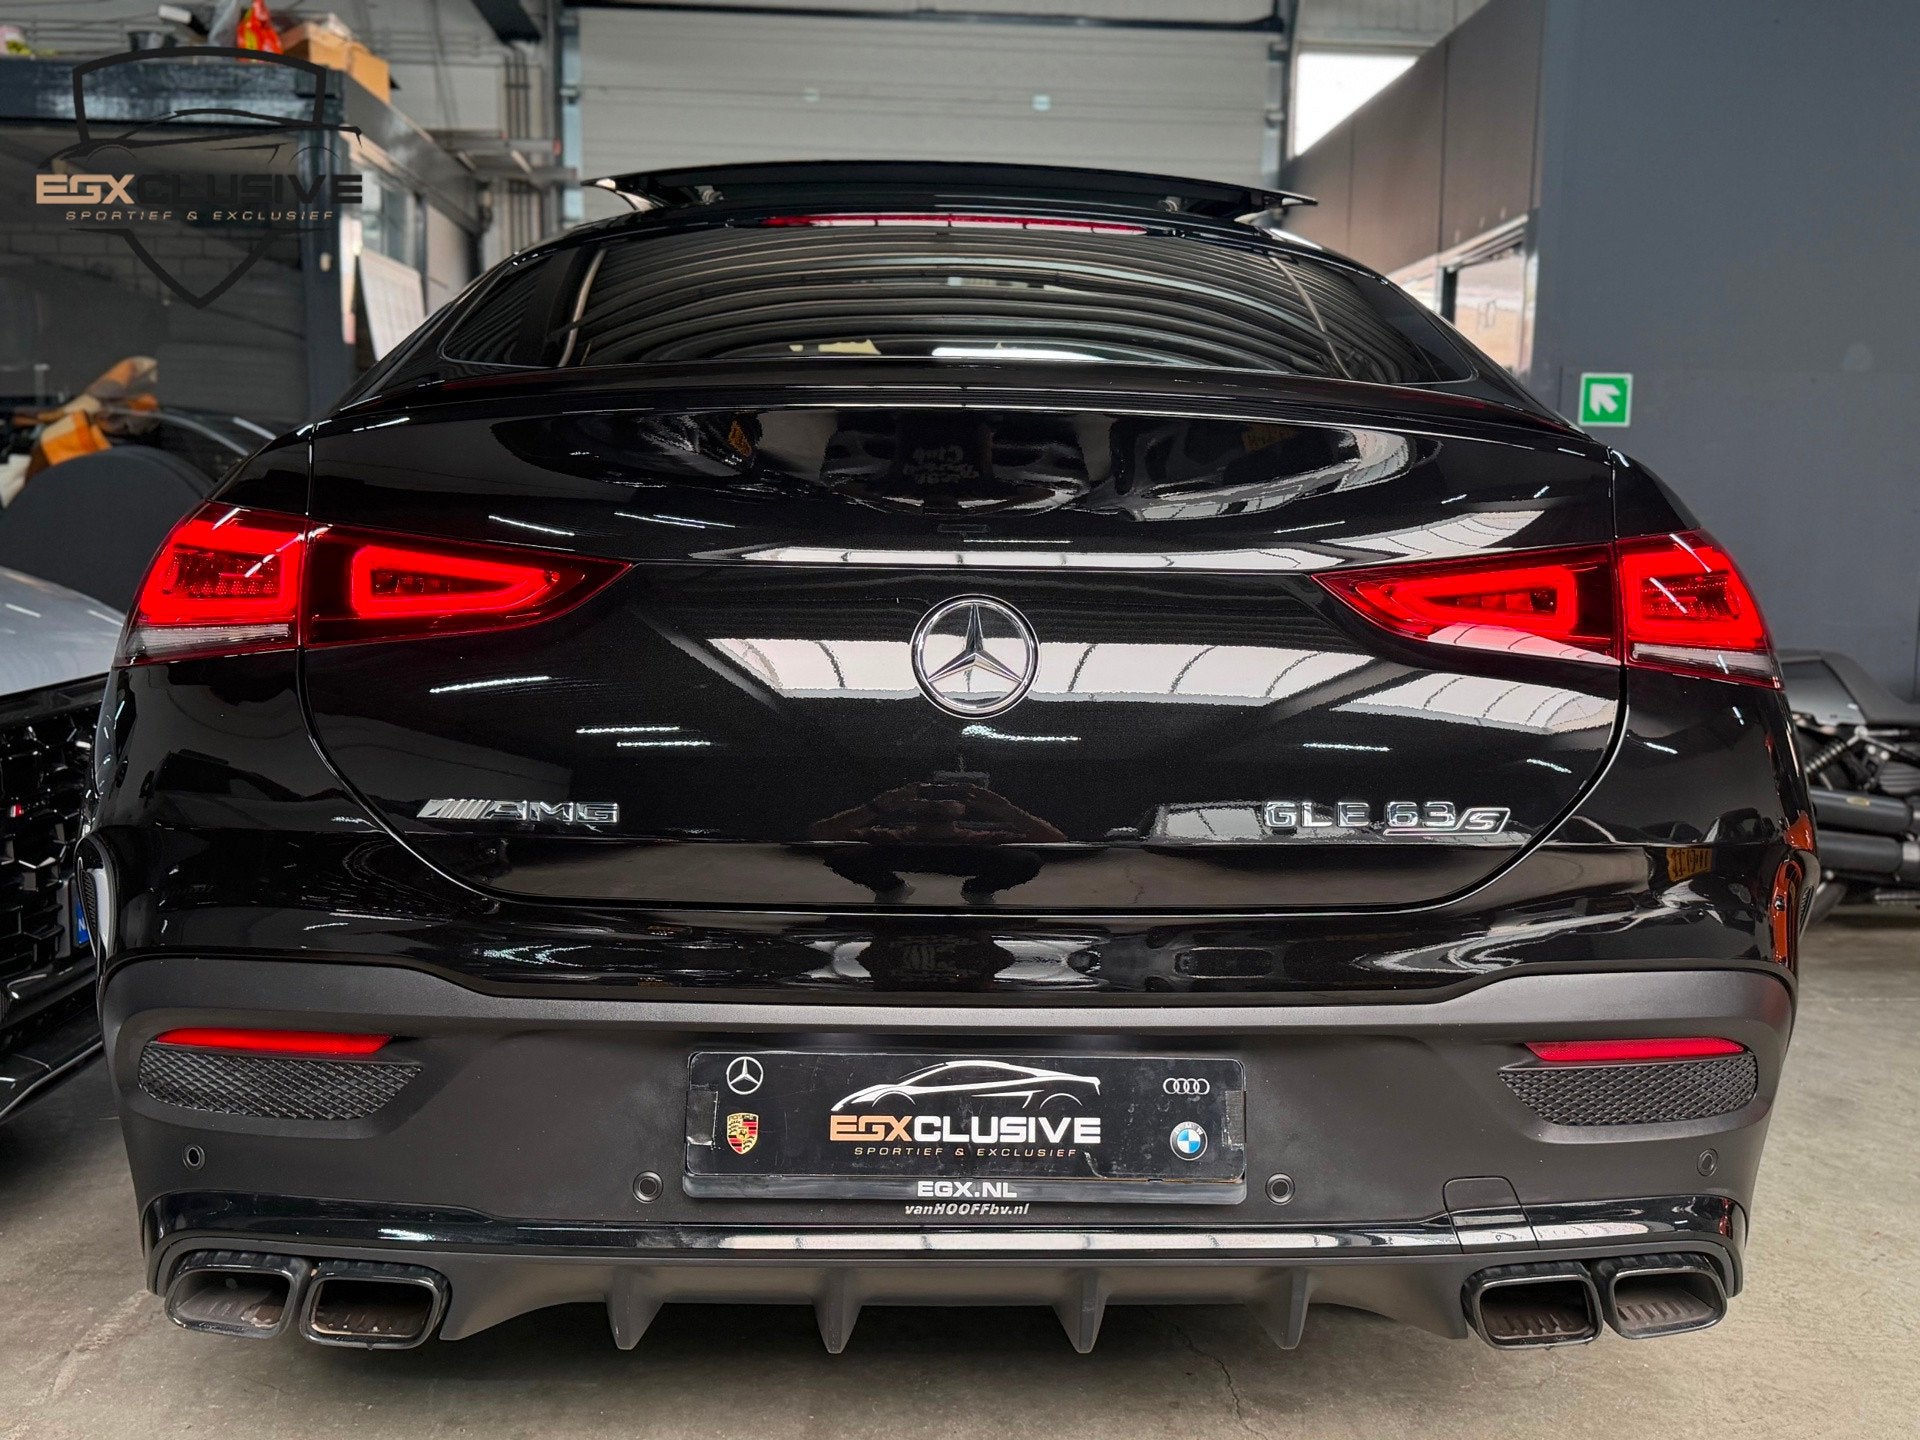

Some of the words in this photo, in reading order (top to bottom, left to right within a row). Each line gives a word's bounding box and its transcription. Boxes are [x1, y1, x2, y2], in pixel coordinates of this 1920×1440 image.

[481, 799, 619, 823] AMG
[1264, 801, 1371, 828] GLE
[829, 1114, 1101, 1144] EGXCLUSIVE
[854, 1147, 944, 1157] SPORTIEF
[954, 1148, 967, 1157] &
[976, 1148, 1077, 1158] EXCLUSIEF
[917, 1180, 1018, 1199] EGX.NL
[904, 1202, 1030, 1216] vanHOOFFbv.nl
